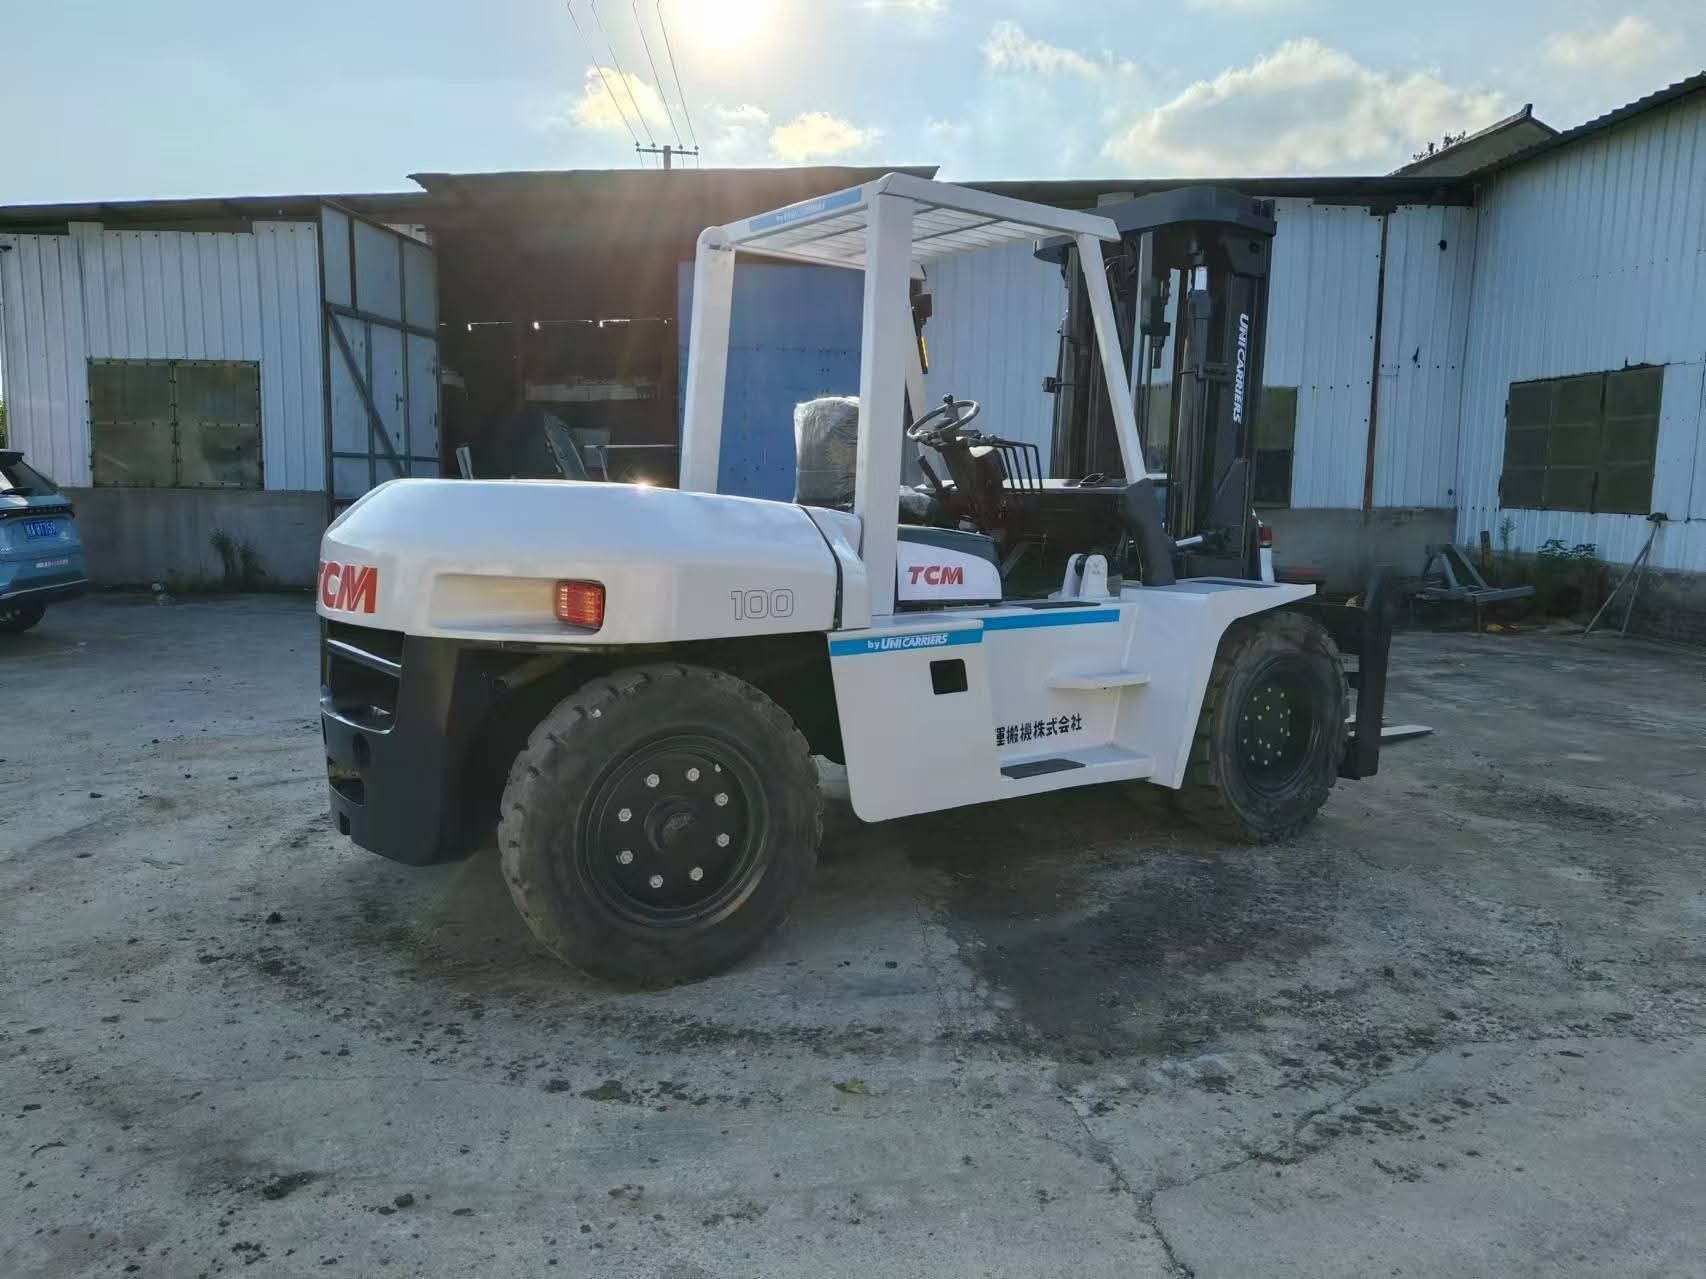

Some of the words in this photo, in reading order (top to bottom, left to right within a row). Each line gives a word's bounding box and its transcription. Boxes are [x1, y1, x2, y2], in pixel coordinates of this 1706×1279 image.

[1232, 313, 1249, 424] UNICARRIERS
[908, 566, 964, 585] TCM
[731, 588, 794, 621] 100
[867, 641, 880, 651] by
